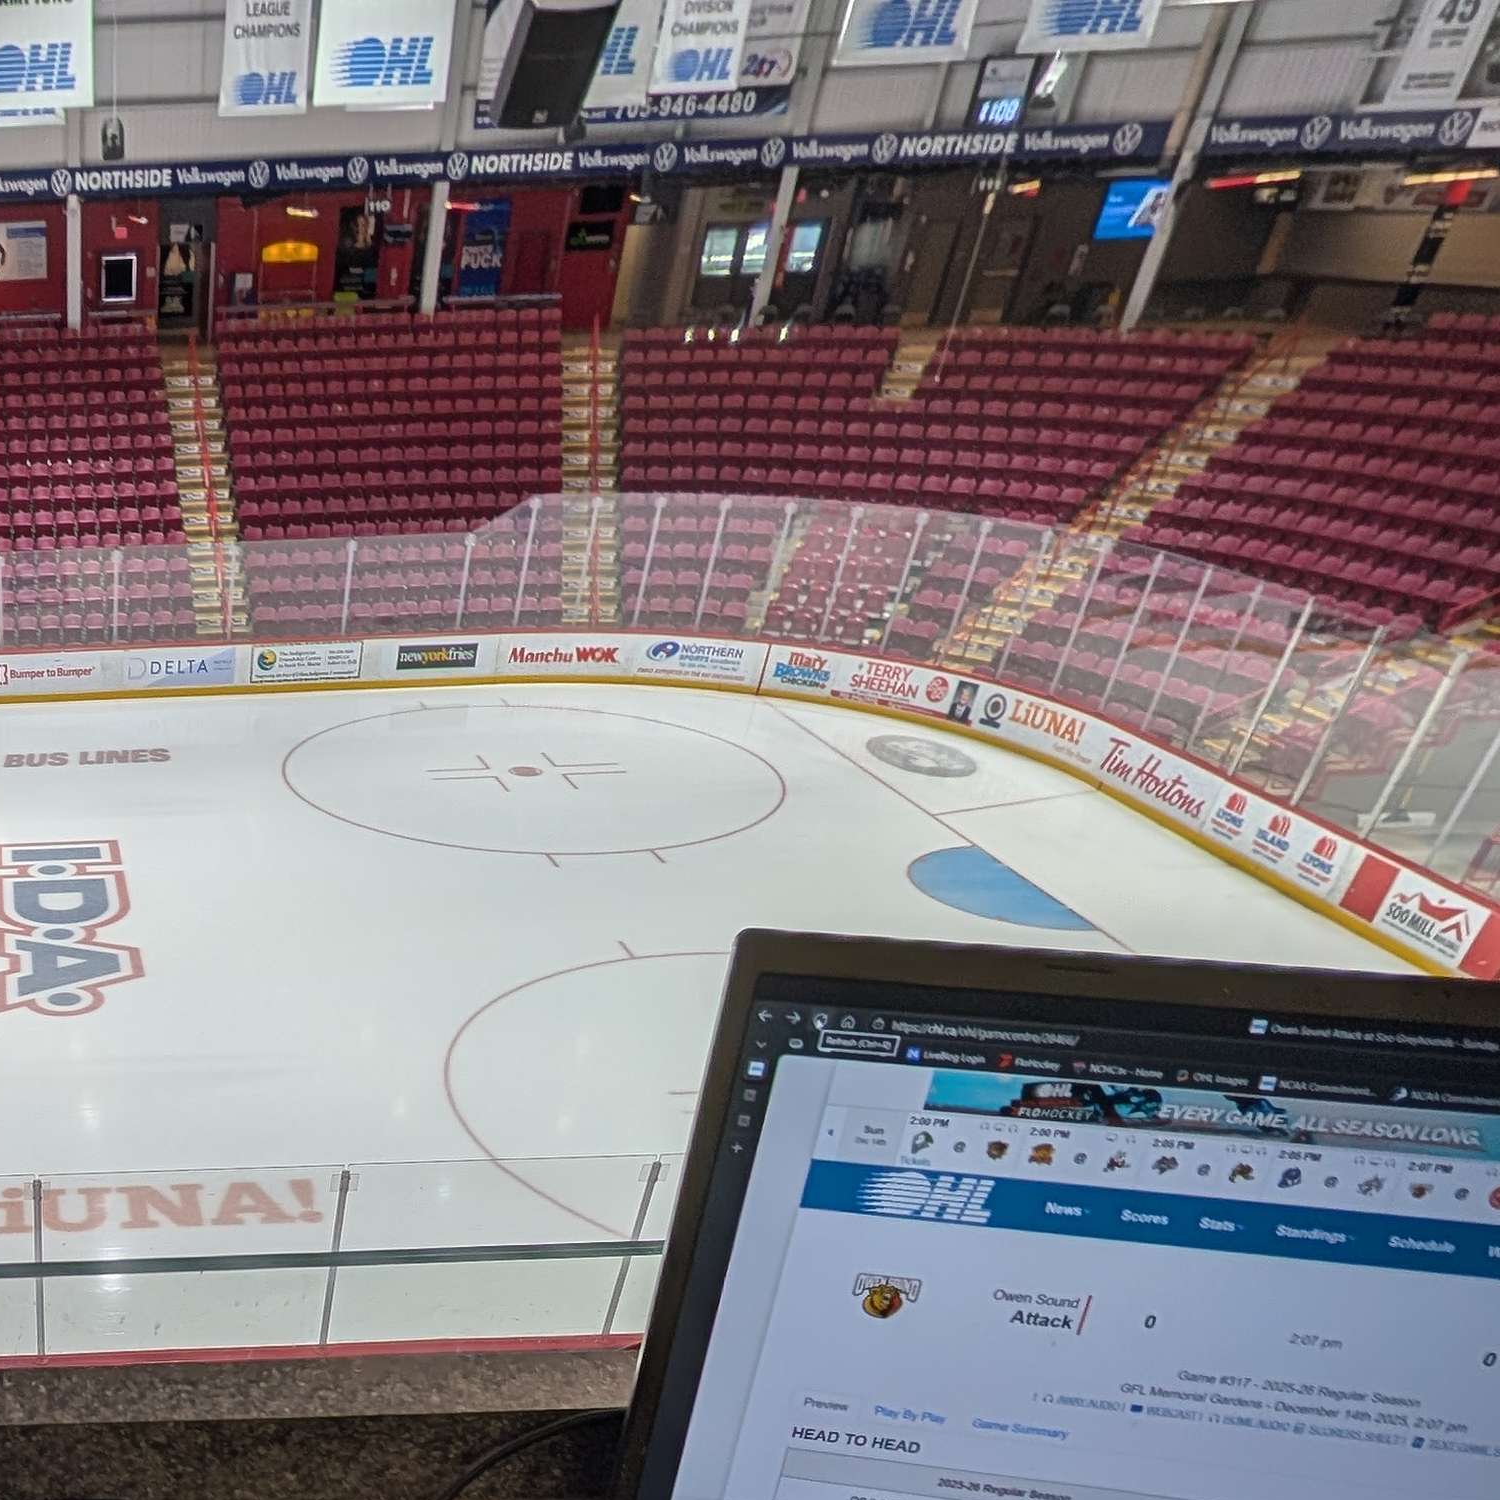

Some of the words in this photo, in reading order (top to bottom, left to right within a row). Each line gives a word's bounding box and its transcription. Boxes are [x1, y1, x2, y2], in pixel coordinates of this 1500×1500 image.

[245, 0, 291, 17] LEAGUE
[233, 23, 301, 40] CHAMPIONS
[671, 19, 740, 36] CHAMPIONS
[330, 36, 434, 88] OHL
[234, 72, 298, 106] OHL
[1024, 130, 1109, 153] Volkswagen
[1210, 122, 1298, 147] Volkswagen
[793, 139, 869, 163] Volkswagen
[900, 135, 1017, 158] NORTHSIDE
[471, 152, 573, 175] NORTHSIDE
[578, 150, 650, 170] Volkswagen
[75, 168, 172, 190] NORTHSIDE
[177, 166, 245, 188] Volkswagen
[508, 648, 573, 664] Manchu
[575, 647, 620, 664] WOK
[681, 643, 745, 660] NORTHERN
[9, 668, 44, 681] Bumper
[46, 668, 55, 678] to
[56, 666, 95, 680] Bumper
[150, 658, 209, 675] DELTA
[866, 662, 913, 681] TERRY
[780, 677, 820, 689] CHICKEN
[850, 674, 920, 699] SHEEHAN
[1008, 700, 1087, 745] LiUNA!
[3, 752, 69, 768] BUS
[79, 748, 172, 765] LINES
[1100, 737, 1134, 778] Tim
[1133, 750, 1206, 820] Hortons
[1215, 808, 1245, 828] LYONS
[1301, 852, 1334, 875] LYONS
[1408, 912, 1436, 939] MILL
[1018, 1106, 1095, 1121] FLOHOCKEY
[1158, 1103, 1223, 1124] EVERY
[1290, 1115, 1330, 1133] ALL
[1331, 1118, 1420, 1141] SEASON
[1045, 1202, 1082, 1218] News
[1120, 1209, 1169, 1226] Scores
[1199, 1217, 1235, 1232] Stats
[1276, 1224, 1347, 1245] Standings
[1388, 1235, 1456, 1255] Schedule
[994, 1289, 1032, 1304] Owen
[1036, 1292, 1081, 1310] Sound
[1010, 1310, 1074, 1331] Attack
[804, 1397, 850, 1412] Preview
[792, 1426, 840, 1444] HEAD
[846, 1433, 868, 1447] TO
[871, 1437, 921, 1454] HEAD
